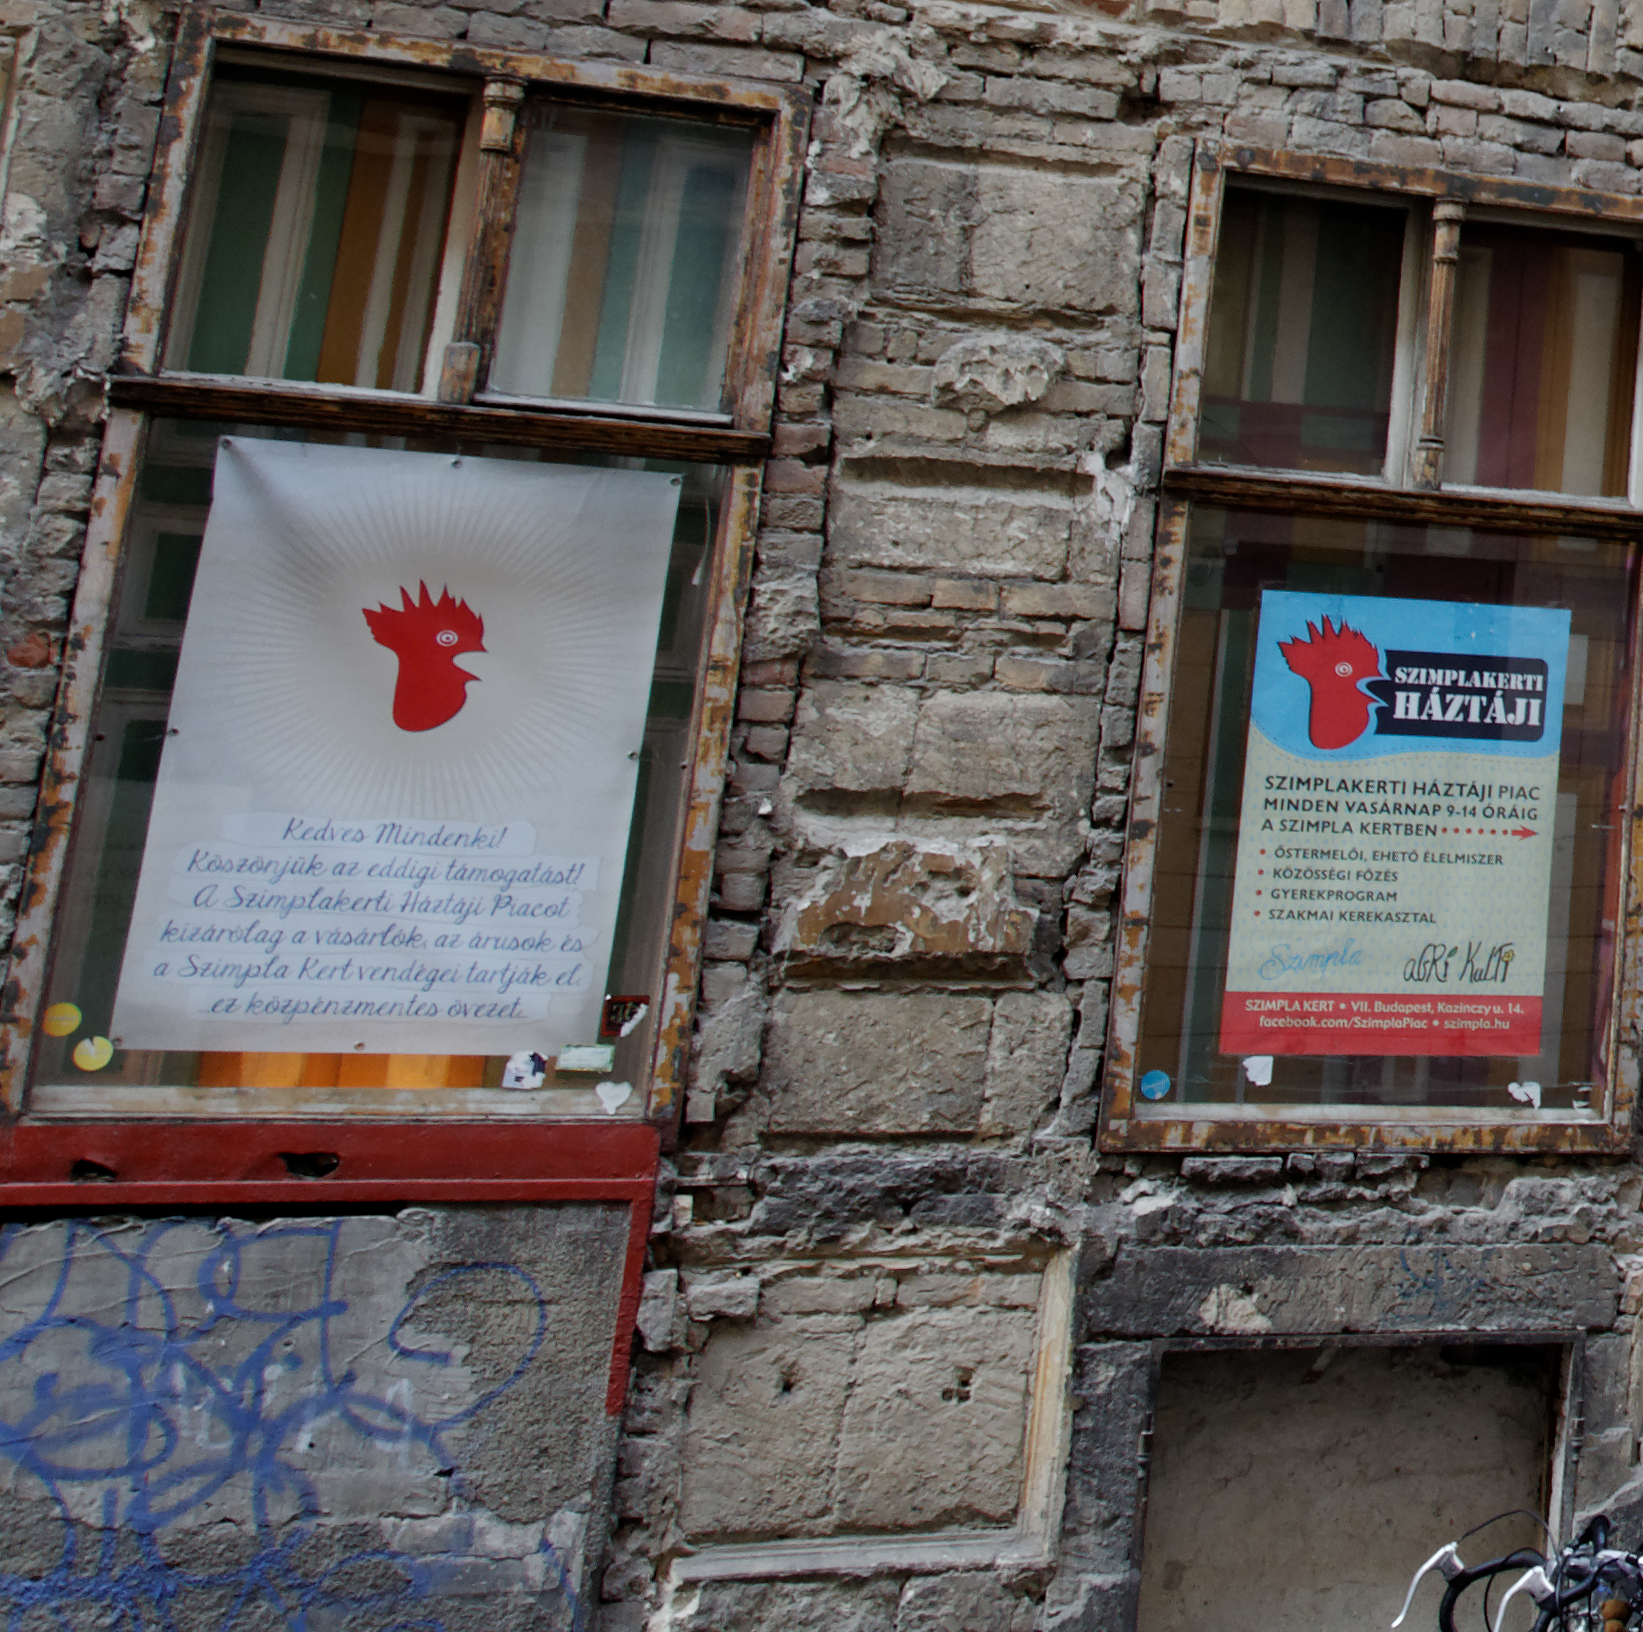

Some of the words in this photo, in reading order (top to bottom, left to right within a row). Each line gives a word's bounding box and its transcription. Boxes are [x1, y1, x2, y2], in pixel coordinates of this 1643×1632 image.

[1394, 666, 1543, 691] SZIMPLAKERTI
[1393, 686, 1542, 726] HÁZTÁJI
[1265, 775, 1406, 795] SZIMPLAKERTI
[1413, 778, 1492, 802] HÁZTÁJI
[1498, 785, 1540, 800] PIAC
[1264, 797, 1339, 813] MINDEN
[1345, 799, 1442, 817] VASÁRNAP
[1447, 804, 1477, 818] 9-14
[1482, 802, 1538, 820] ÓRÁIG
[282, 817, 366, 843] Kedves
[374, 822, 508, 850] Mindenki!
[1261, 818, 1274, 831] A
[1279, 819, 1354, 834] SZIMPLA
[1360, 821, 1438, 837] KERTBEN
[187, 848, 327, 884] Köszönjük
[332, 861, 361, 877] az
[367, 856, 441, 889] eddigi
[444, 859, 585, 892] támogatást!
[1423, 849, 1504, 865] ÉLELMISZER
[1273, 866, 1351, 880] KÖZÖSSÉGI
[193, 884, 220, 908] A
[223, 885, 395, 919] Szimplakerti
[400, 890, 485, 925] Háztáji
[489, 894, 571, 918] Piacot
[1271, 888, 1397, 901] GYEREKPROGRAM
[1268, 909, 1333, 921] SZAKMAI
[1339, 911, 1437, 924] KEREKASZTAL
[159, 919, 287, 954] kizárólag
[291, 930, 309, 944] a
[434, 933, 464, 949] az
[468, 930, 556, 953] árusok
[560, 933, 583, 952] és
[1259, 937, 1363, 981] Szimpla
[153, 962, 171, 977] a
[177, 954, 292, 989] Szimpla
[297, 956, 354, 981] Kert
[358, 959, 462, 992] vendégei
[465, 961, 551, 994] tartják
[244, 992, 443, 1025] közpénzmentes
[1245, 999, 1300, 1012] SZIMPLA
[1303, 1000, 1335, 1012] KERT
[1374, 1001, 1435, 1015] Budapest,
[1437, 1002, 1491, 1016] Kazinczy
[1493, 1005, 1504, 1014] u.
[1259, 1016, 1428, 1030] facebook.com/SzimplaPiac
[1444, 1018, 1510, 1031] szimpla.hu
